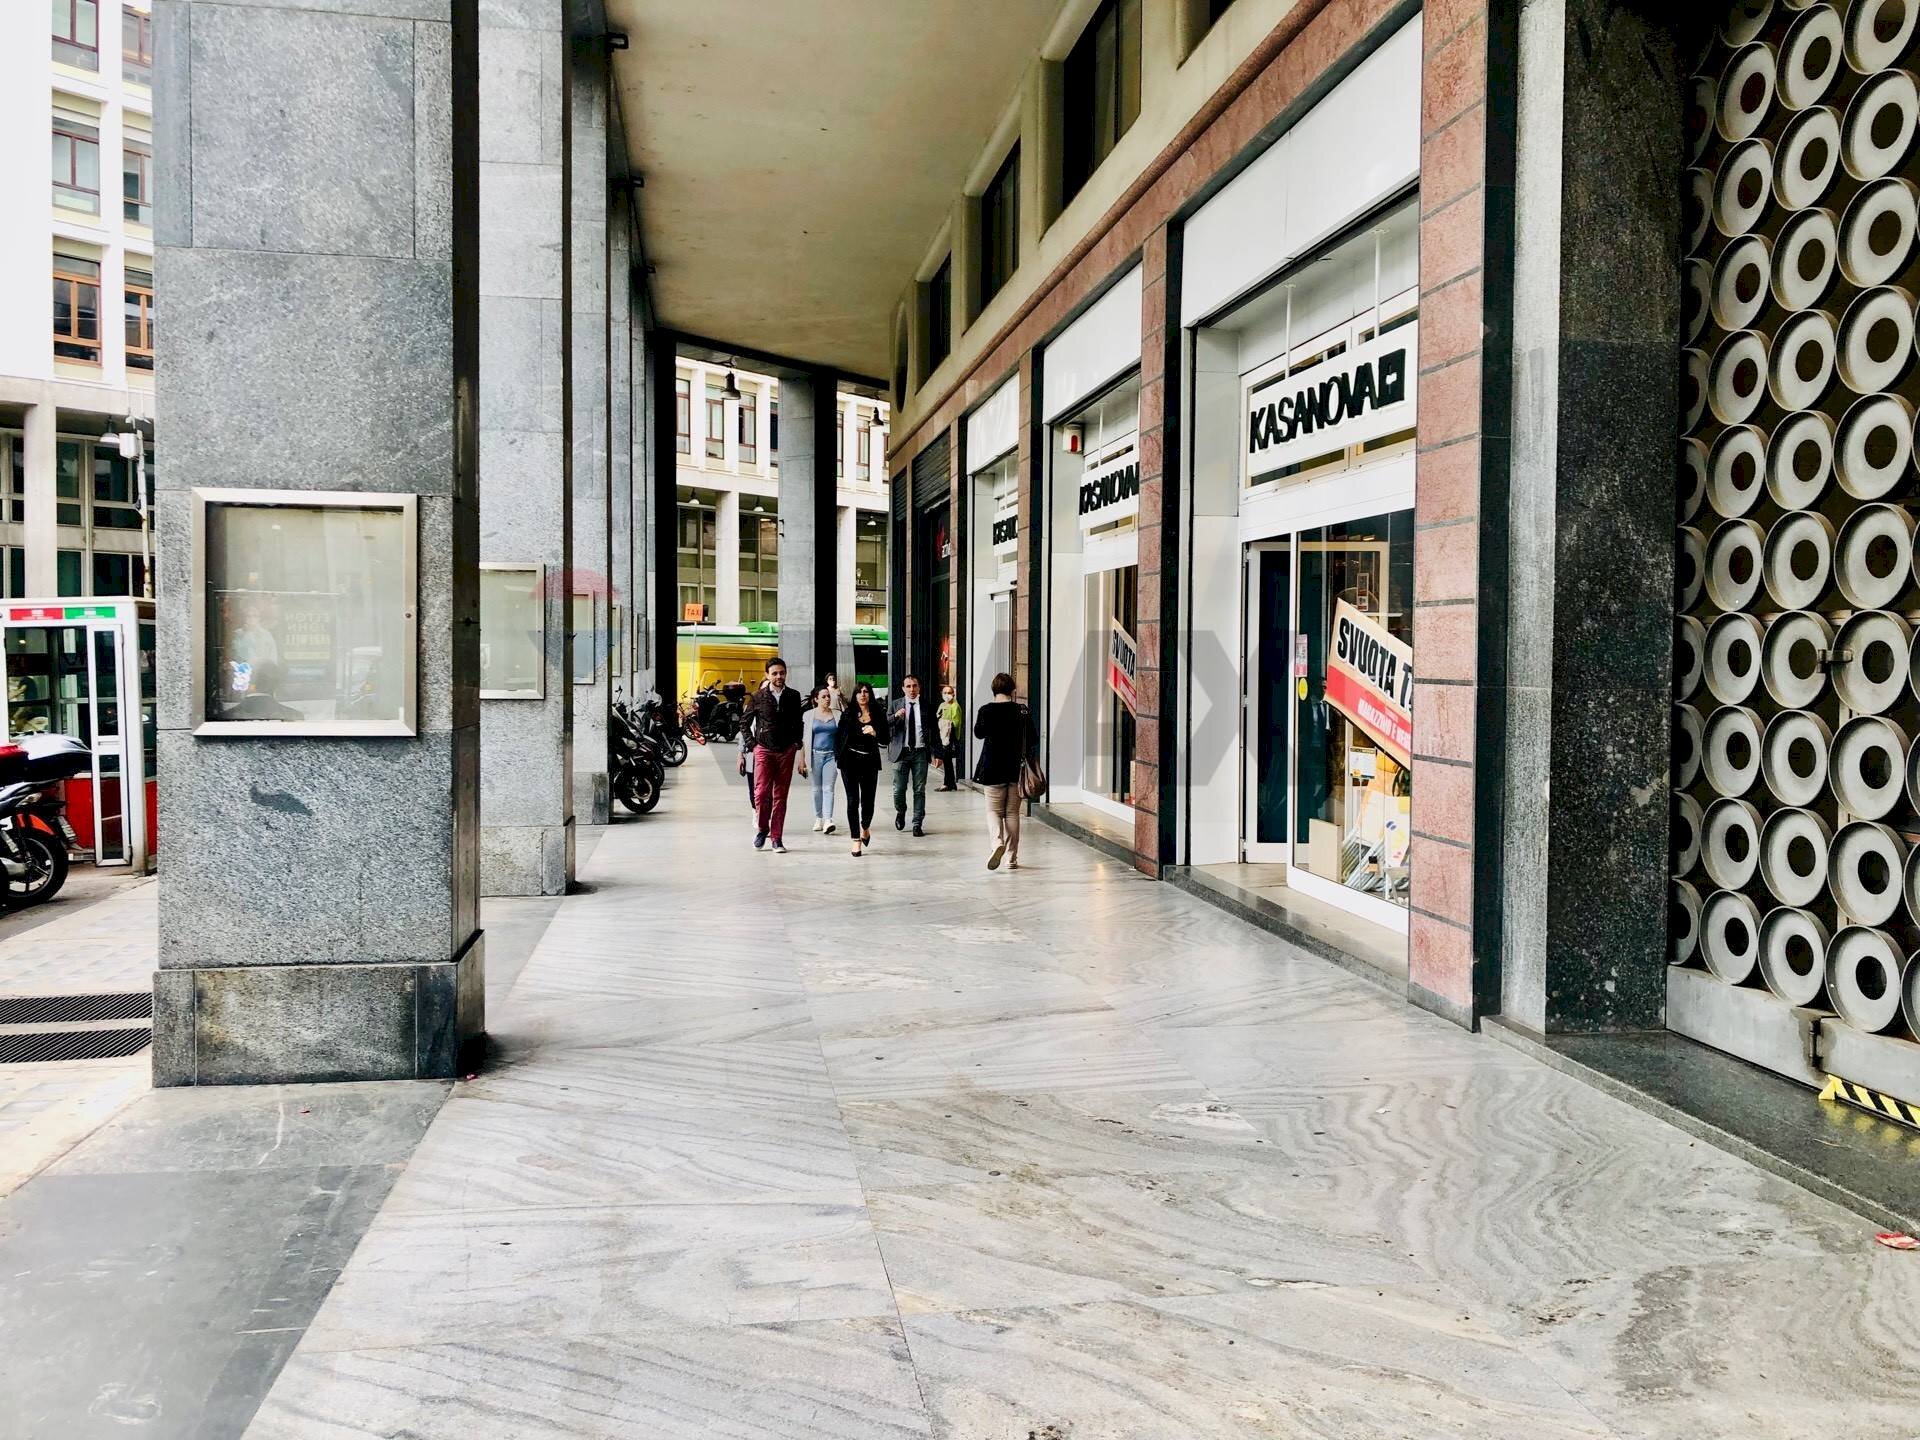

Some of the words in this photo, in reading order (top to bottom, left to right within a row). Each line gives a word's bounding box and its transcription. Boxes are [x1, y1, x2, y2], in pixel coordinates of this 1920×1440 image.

[1250, 362, 1379, 454] KASANOVA
[687, 608, 702, 617] TAXI
[1337, 617, 1397, 699] SVUOTA
[1400, 661, 1412, 711] T
